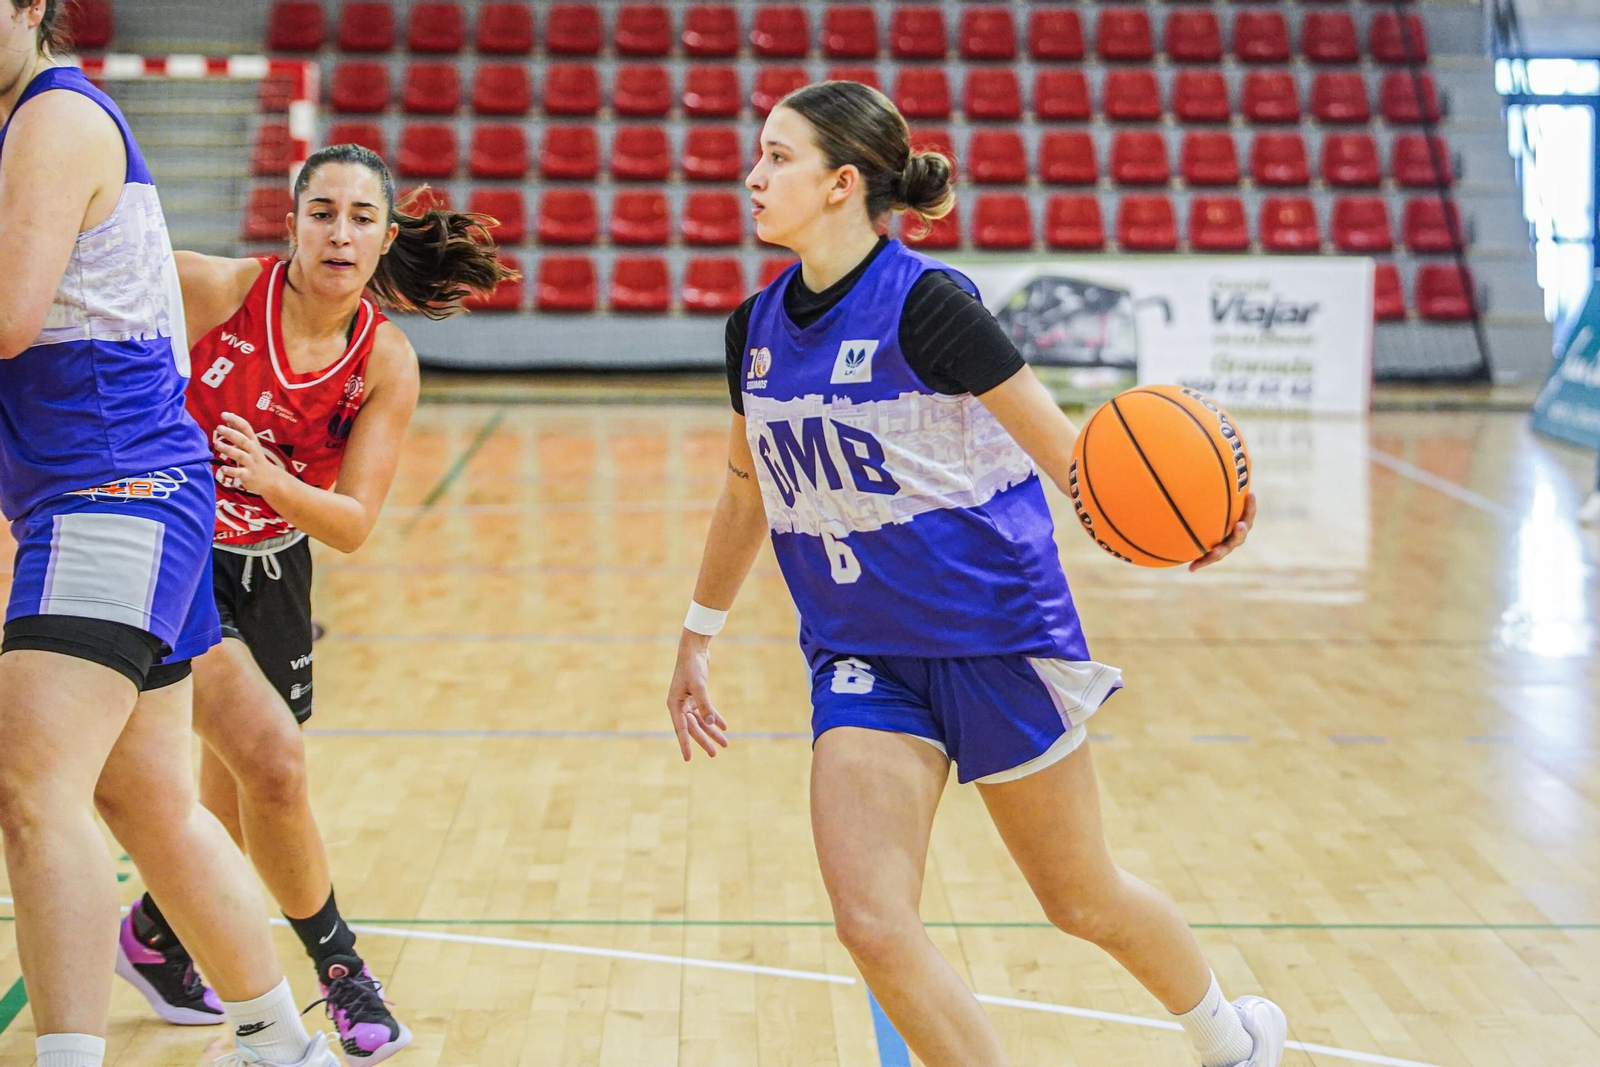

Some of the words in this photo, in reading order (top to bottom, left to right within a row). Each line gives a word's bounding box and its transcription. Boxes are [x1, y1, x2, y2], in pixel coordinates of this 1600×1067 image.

[1209, 291, 1320, 331] Viajar
[220, 331, 255, 354] vive
[200, 356, 235, 389] 8
[758, 416, 901, 508] GMB
[819, 520, 862, 585] 6
[290, 653, 314, 670] viv
[830, 657, 876, 694] 6
